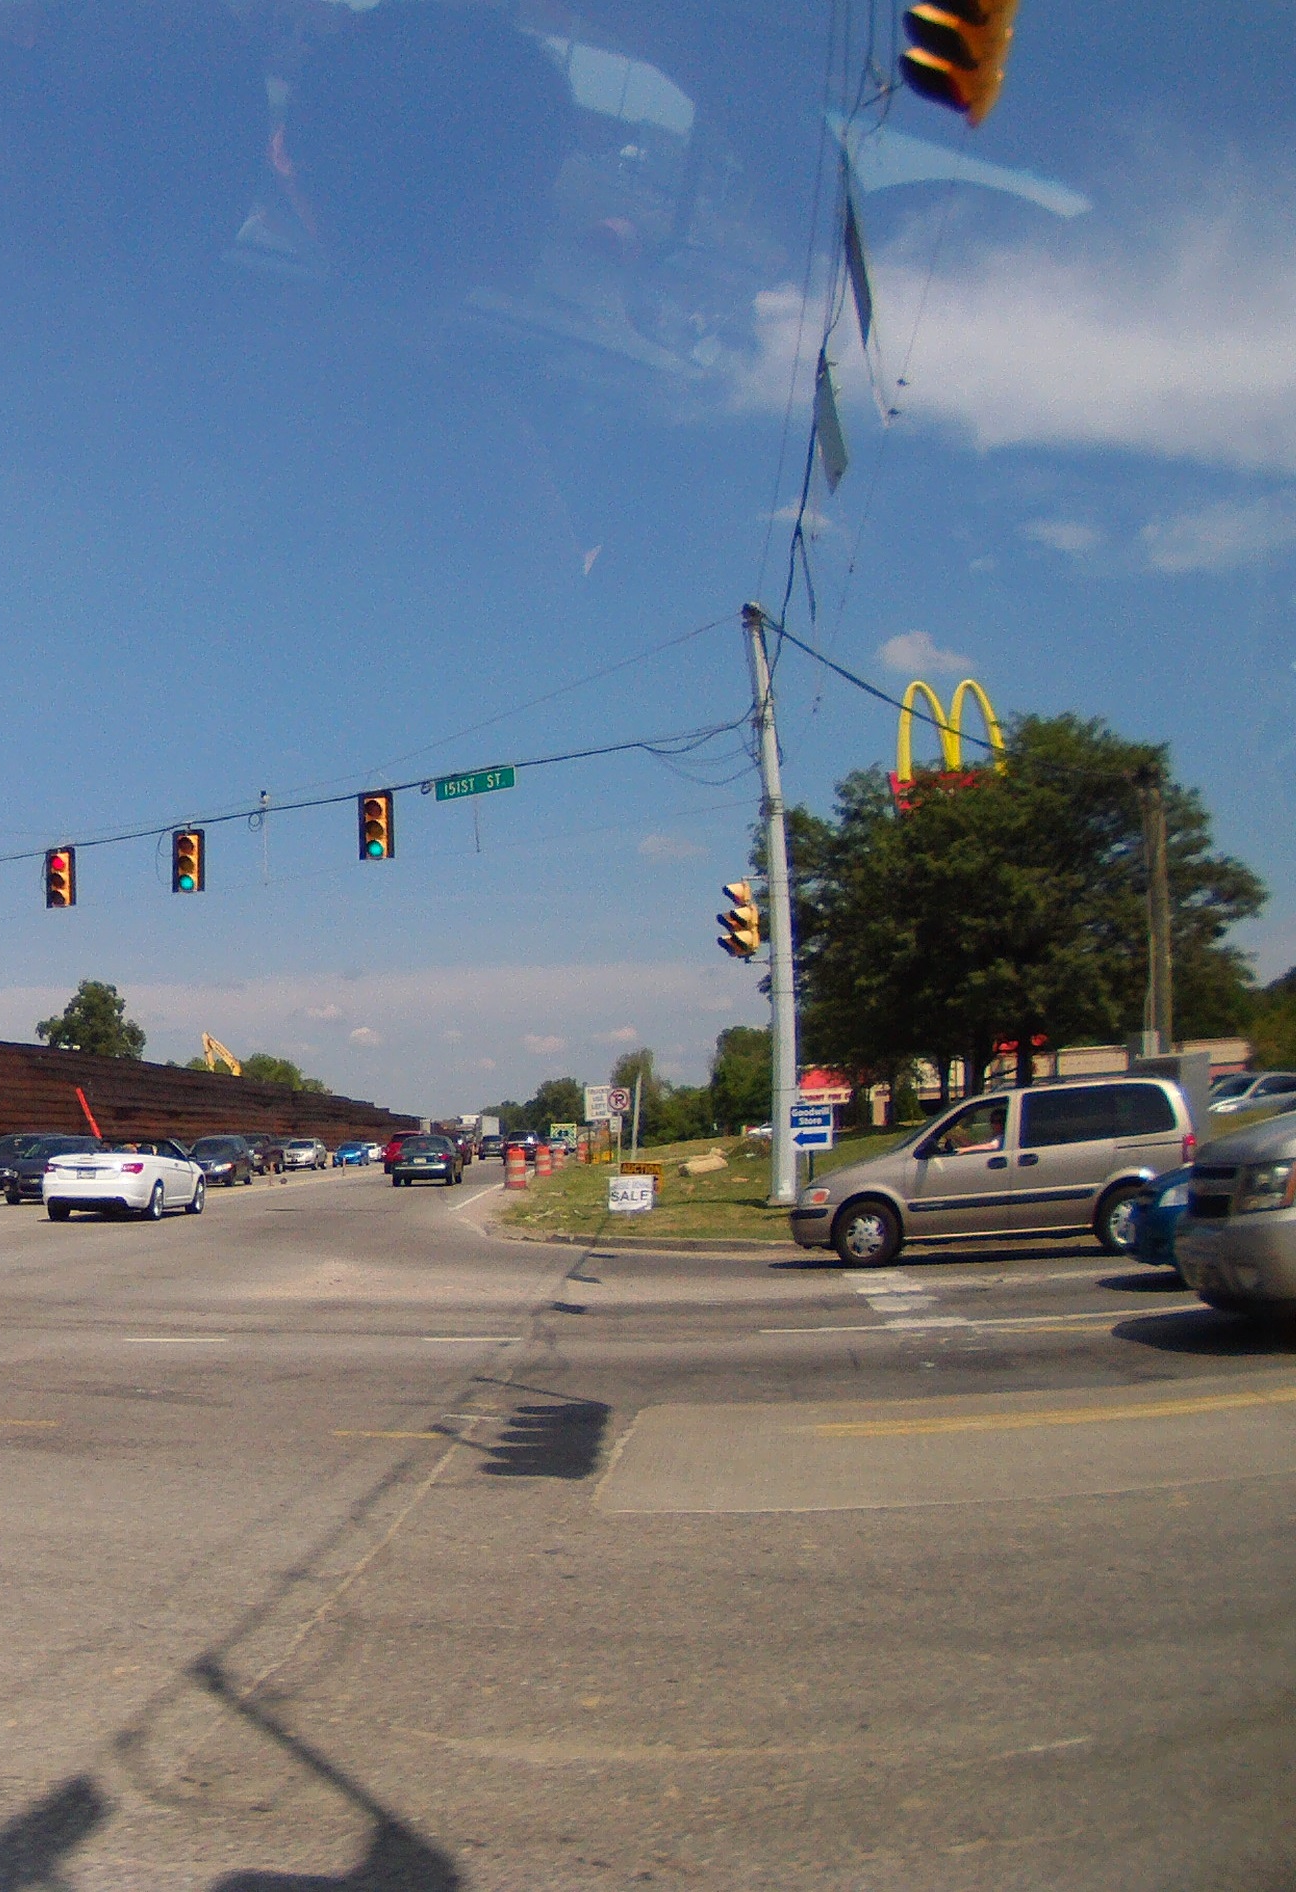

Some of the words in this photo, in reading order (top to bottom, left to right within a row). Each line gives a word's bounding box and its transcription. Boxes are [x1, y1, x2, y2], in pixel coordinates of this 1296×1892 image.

[444, 777, 475, 797] 151ST
[486, 773, 501, 788] ST
[791, 1107, 829, 1117] Goodwill
[798, 1117, 822, 1125] Store
[611, 1189, 650, 1202] SALE
